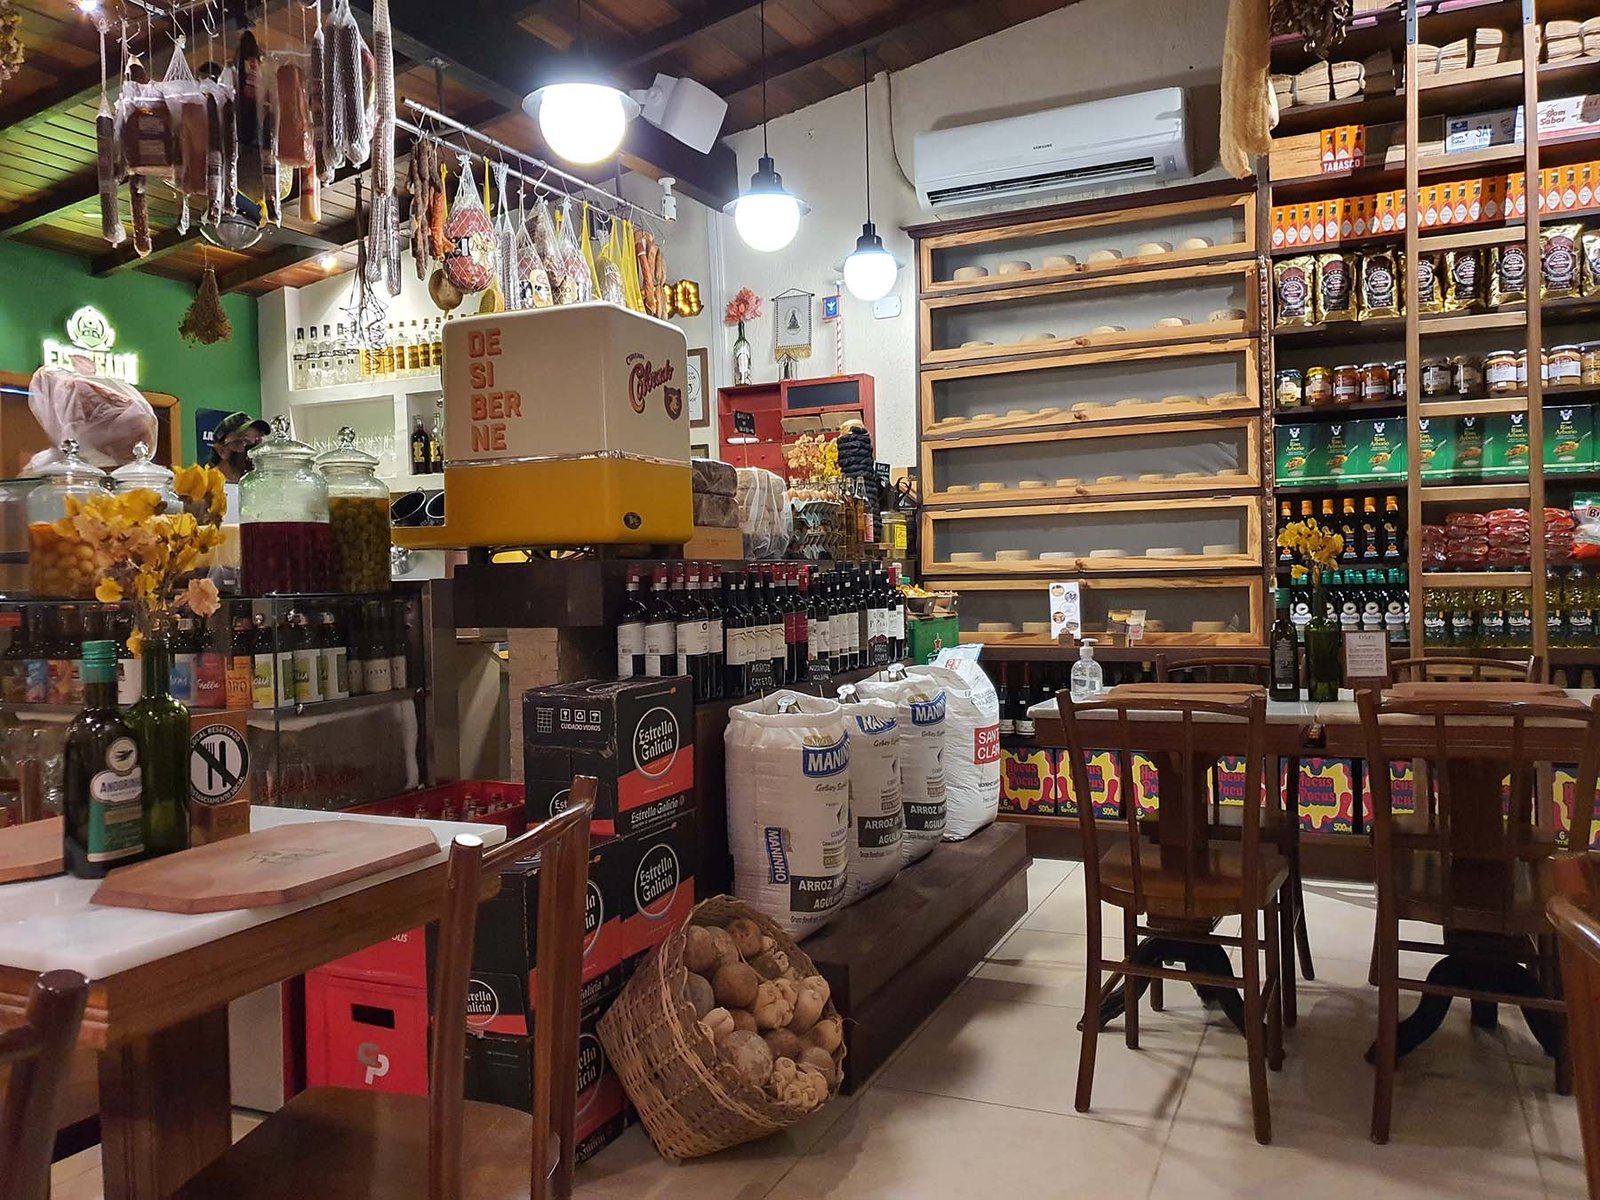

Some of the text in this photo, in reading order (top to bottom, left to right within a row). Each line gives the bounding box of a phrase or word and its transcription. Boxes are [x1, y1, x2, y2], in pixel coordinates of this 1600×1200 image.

[1323, 159, 1360, 172] TABASCO
[468, 329, 502, 358] DE
[469, 361, 495, 389] SI
[471, 391, 523, 421] BER
[471, 423, 508, 452] NE
[207, 726, 241, 742] RESERVADO
[560, 723, 601, 732] CUIDADO VIDROS
[638, 720, 673, 745] Estrella
[978, 727, 999, 745] SANT
[641, 738, 673, 761] Galicia
[630, 805, 656, 824] Estrella
[656, 797, 679, 814] Galicia
[910, 804, 938, 815] ARROZ
[865, 818, 894, 829] ARROZ
[768, 829, 787, 882] MANINHO
[640, 857, 673, 887] Estrella
[642, 874, 674, 901] Galicia
[798, 879, 833, 891] ARROZ
[467, 1001, 492, 1013] alicia
